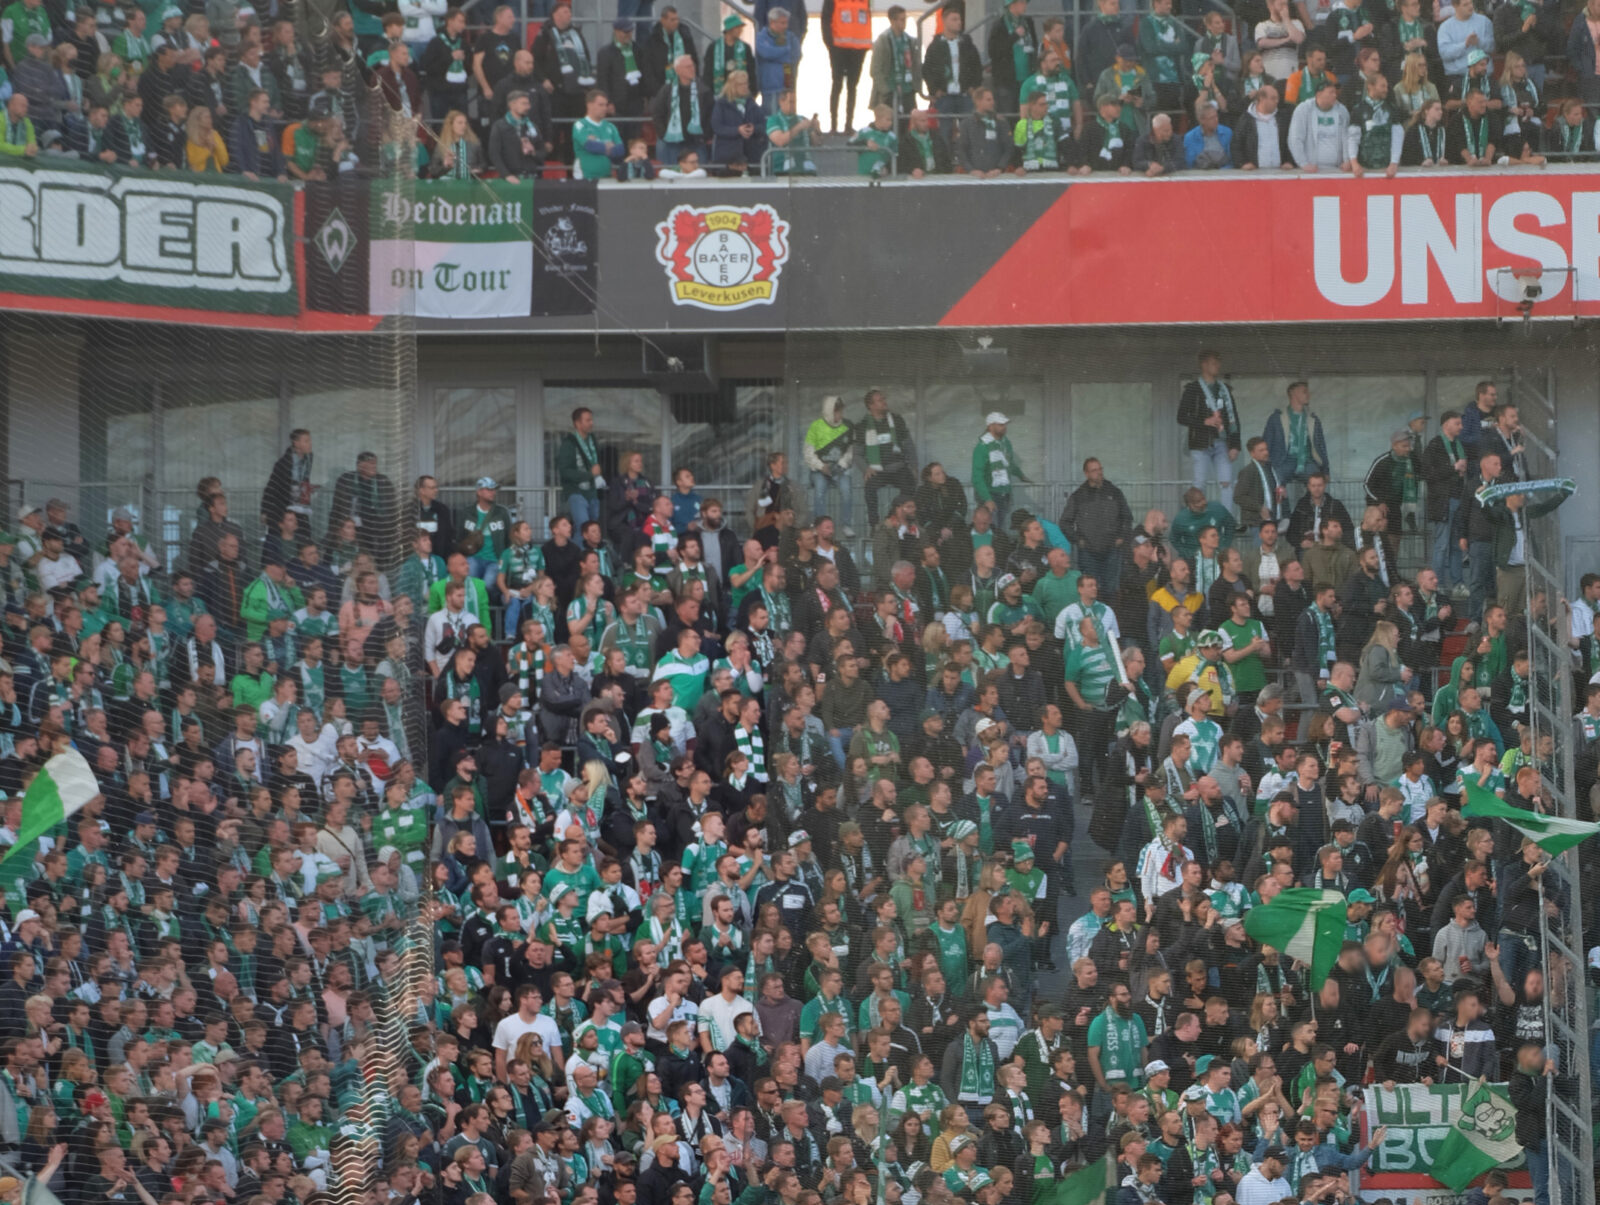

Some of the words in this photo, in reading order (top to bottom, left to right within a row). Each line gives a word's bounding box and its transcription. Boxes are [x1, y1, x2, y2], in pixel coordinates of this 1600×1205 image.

[382, 192, 522, 226] Heidenau
[708, 214, 738, 226] 1904
[699, 253, 749, 263] BAYER
[719, 233, 729, 283] BAYER
[391, 267, 424, 290] on
[434, 262, 511, 292] Tour
[682, 284, 765, 303] Leverkusen
[1374, 1084, 1470, 1125] ULT
